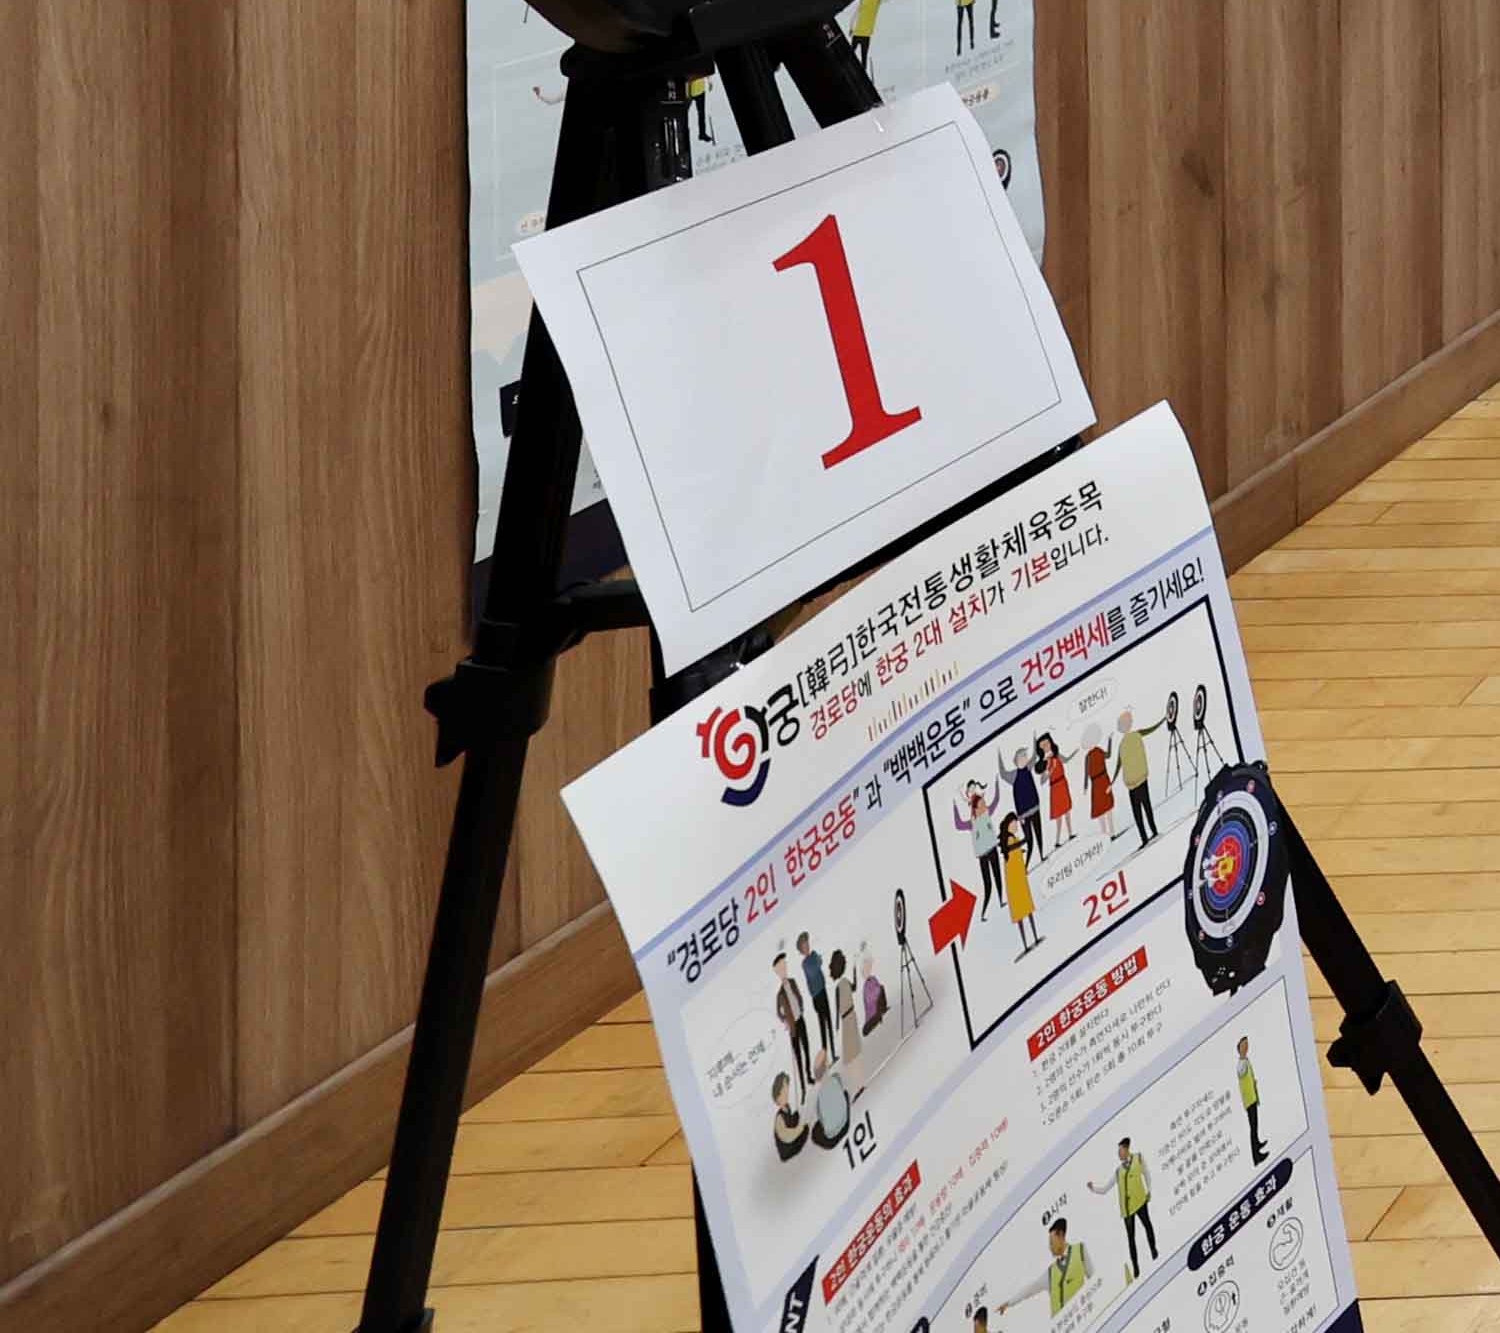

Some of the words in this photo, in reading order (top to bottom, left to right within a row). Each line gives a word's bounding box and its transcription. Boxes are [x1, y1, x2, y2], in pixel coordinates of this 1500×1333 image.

[772, 213, 923, 471] 1
[809, 670, 873, 741] 경로당에
[875, 641, 910, 686] 한궁
[914, 617, 944, 658] 2대
[947, 580, 1005, 634] 설치가
[1010, 523, 1110, 593] 기본입니다.
[743, 863, 779, 925] 2인
[1020, 605, 1128, 695] 건강백세를
[1129, 557, 1206, 628] 즐기세요!
[1082, 869, 1130, 928] 2인
[1036, 1021, 1057, 1048] 2인
[1058, 977, 1109, 1029] 한궁운동
[1110, 955, 1138, 986] 방법
[842, 1110, 877, 1170] 1인
[1200, 1222, 1226, 1258] 한궁
[1227, 1198, 1252, 1233] 운동
[1253, 1174, 1278, 1208] 효과
